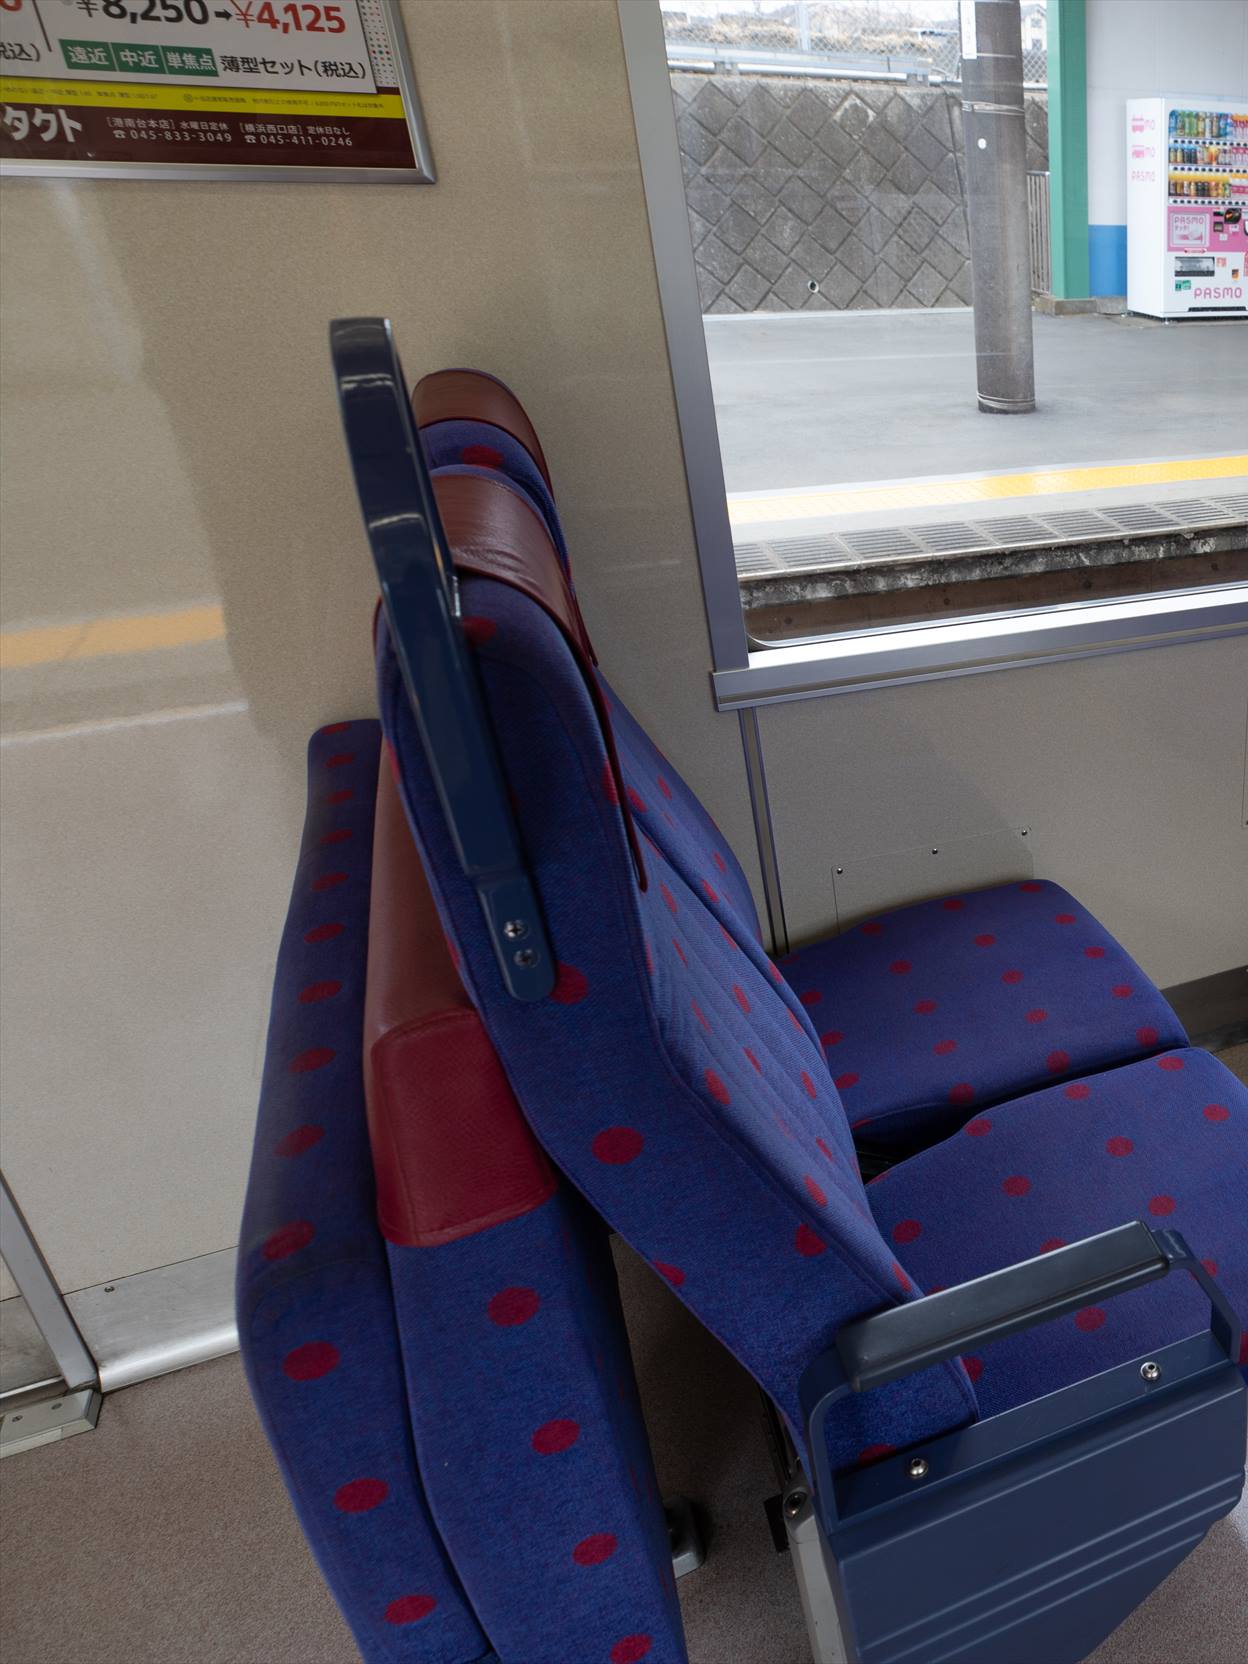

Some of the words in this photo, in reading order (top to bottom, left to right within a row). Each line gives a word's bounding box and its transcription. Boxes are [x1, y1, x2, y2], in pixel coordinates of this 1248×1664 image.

[230, 0, 346, 34] ¥4,125
[68, 45, 110, 66] 遠近
[120, 49, 161, 69] 中近
[167, 51, 215, 72] 単焦点
[220, 55, 366, 80] 薄型セット(税込)
[130, 129, 232, 143] 045-833-3049
[261, 134, 352, 147] 045-411-0246
[1174, 216, 1204, 225] PASMO
[1194, 287, 1242, 299] PASMO
